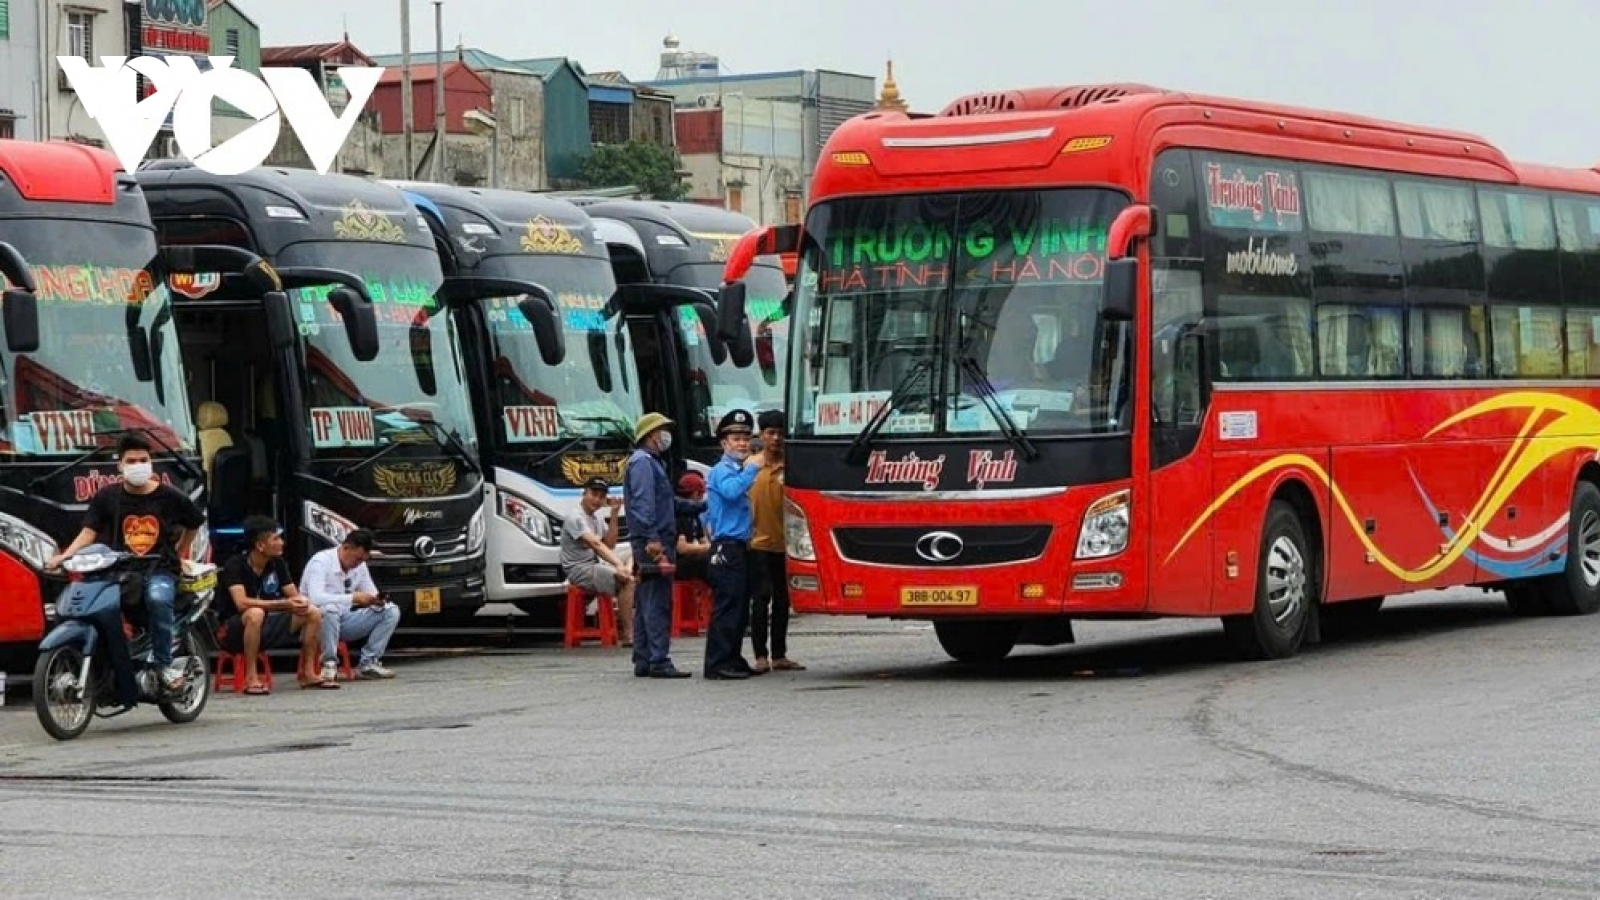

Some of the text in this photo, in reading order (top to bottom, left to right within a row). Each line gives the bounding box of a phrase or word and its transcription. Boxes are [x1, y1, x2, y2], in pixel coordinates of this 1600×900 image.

[1226, 236, 1298, 276] mobihome
[33, 412, 97, 450] VINH
[313, 411, 372, 441] TP VINH
[506, 408, 557, 437] VINH
